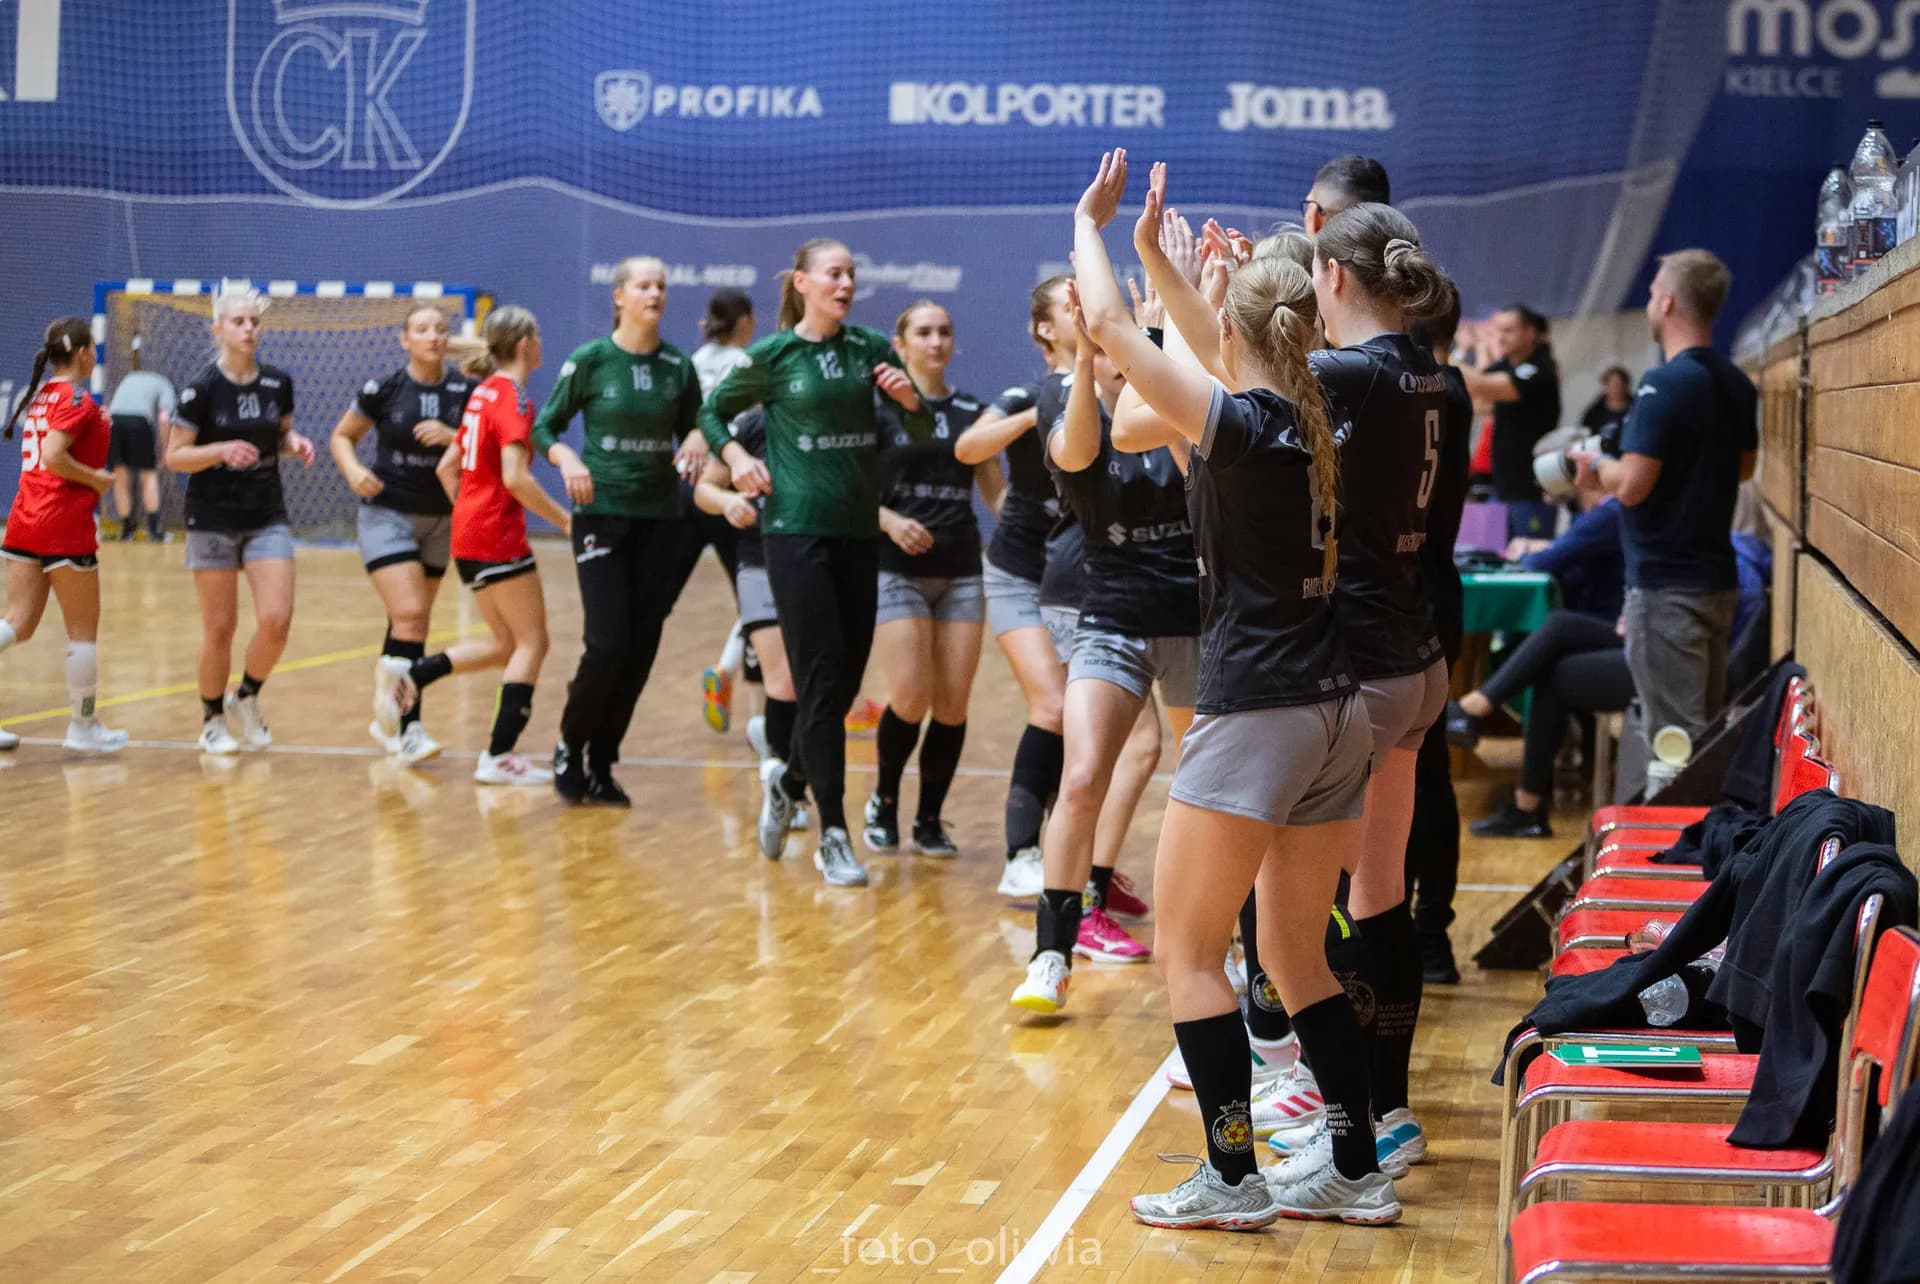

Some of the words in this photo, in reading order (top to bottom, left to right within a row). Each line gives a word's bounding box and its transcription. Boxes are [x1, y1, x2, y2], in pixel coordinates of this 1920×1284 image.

[652, 85, 823, 117] PROFIKA
[917, 82, 1166, 127] KOLPORTER
[1218, 81, 1395, 130] Joma
[631, 364, 653, 391] 16
[816, 350, 843, 379] 12
[238, 392, 260, 419] 20
[1416, 409, 1440, 509] 5
[1132, 520, 1193, 542] SUZU
